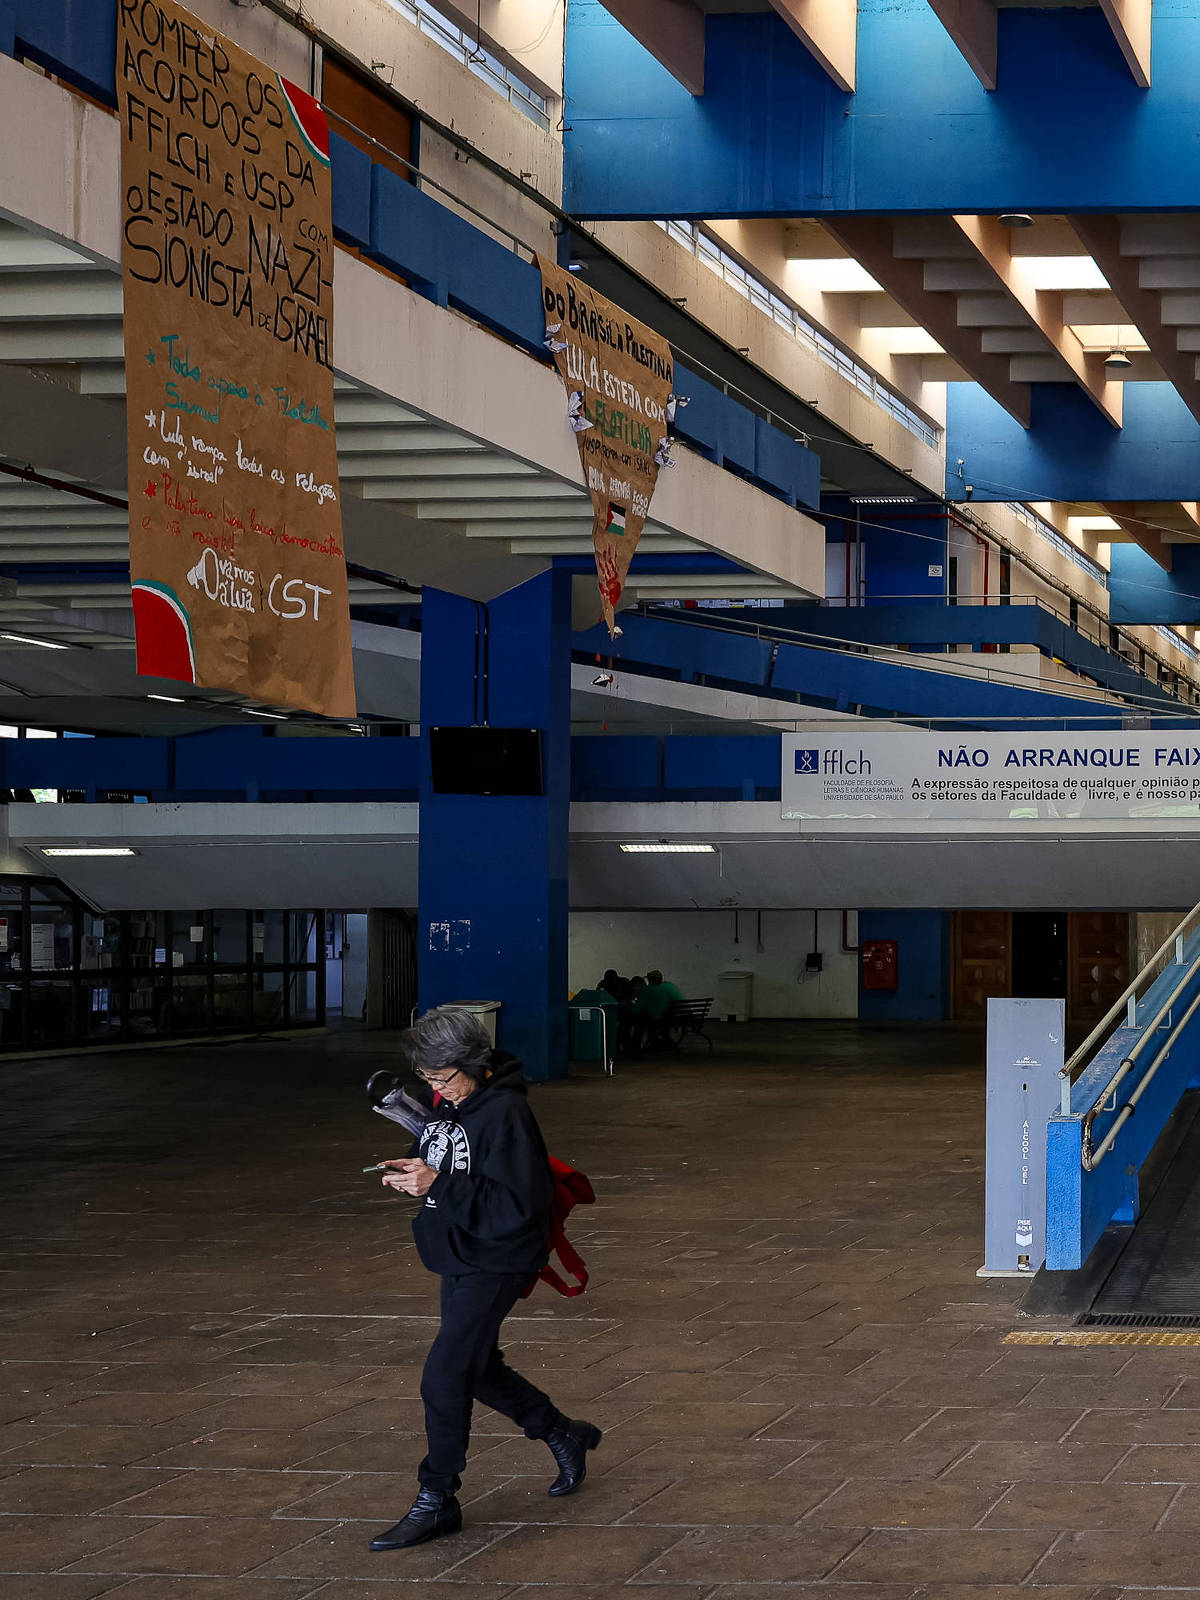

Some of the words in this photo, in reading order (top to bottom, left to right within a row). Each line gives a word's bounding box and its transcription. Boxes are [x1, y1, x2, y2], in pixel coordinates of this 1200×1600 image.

[124, 39, 261, 155] ACORDOS
[286, 141, 317, 196] DA
[246, 72, 283, 128] OS
[126, 91, 210, 185] FFLCH
[241, 159, 295, 223] USP
[299, 218, 329, 252] COM
[544, 286, 566, 321] DO
[273, 293, 335, 373] ISRAEL
[565, 337, 601, 393] LULA
[602, 369, 643, 414] ESTEJA
[644, 396, 667, 425] COM
[823, 749, 872, 775] fflch
[938, 744, 989, 768] NÃO
[1004, 748, 1140, 768] ARRANQUE
[911, 778, 921, 788] A
[923, 778, 989, 791] expressão
[993, 778, 1059, 791] respeitosa
[1062, 777, 1078, 788] de
[1080, 777, 1137, 790] qualquer
[1141, 776, 1189, 789] opinião
[911, 791, 927, 800] os
[930, 790, 978, 800] setores
[981, 790, 997, 800] da
[1001, 789, 1066, 800] Faculdade
[1069, 789, 1077, 800] é
[1088, 789, 1119, 801] livre,
[1123, 791, 1130, 799] e
[1136, 788, 1143, 799] é
[1147, 790, 1186, 799] nosso
